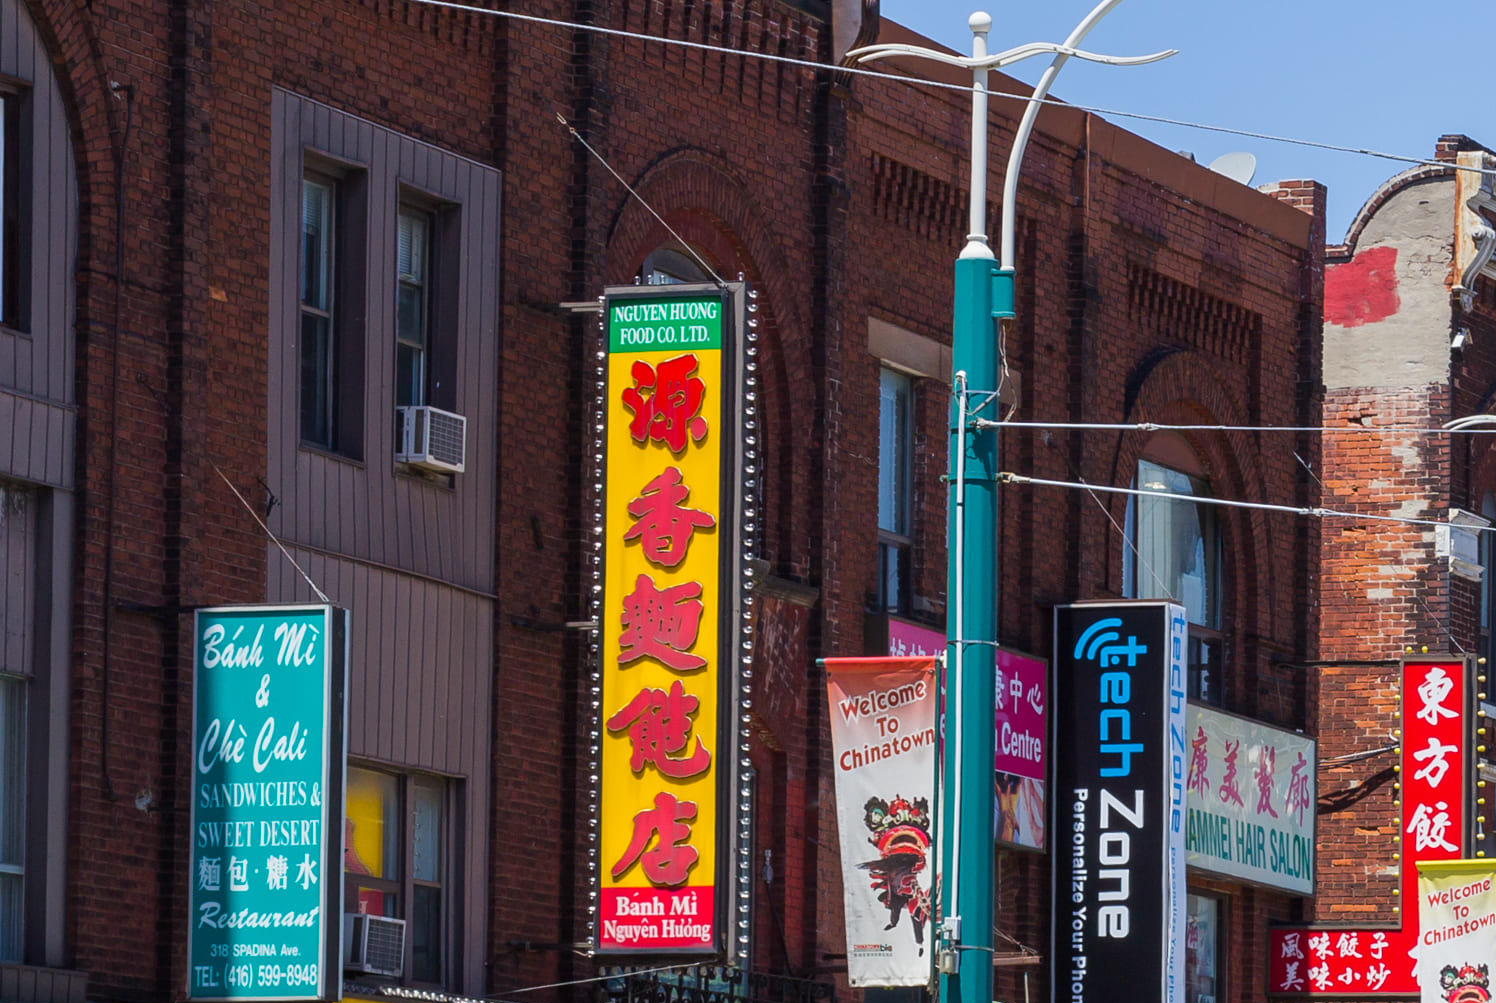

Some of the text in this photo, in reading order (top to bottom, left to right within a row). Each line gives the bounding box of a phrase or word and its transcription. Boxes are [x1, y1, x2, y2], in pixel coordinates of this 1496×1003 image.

[614, 301, 717, 324] NGUYEN HUONG
[620, 325, 711, 345] FOOD CO. LTD.
[203, 623, 264, 669] Bánh
[255, 674, 271, 708] &
[838, 679, 927, 726] Welcome
[876, 715, 900, 741] To
[1170, 612, 1186, 835] tech Zone
[198, 716, 307, 773] Chè Cali
[839, 728, 937, 773] Chinatown
[1001, 722, 1042, 763] Centre
[200, 781, 321, 809] SANDWICHES &
[1098, 635, 1148, 939] tech Zone
[199, 819, 320, 847] SWEET DESERT
[1072, 788, 1089, 903] Personalize
[1235, 820, 1312, 881] HAIR SALON
[615, 890, 698, 917] Bánh Mì
[1427, 877, 1492, 909] Welcome
[198, 901, 320, 929] Restaurant
[1071, 906, 1088, 951] Your
[1453, 904, 1470, 921] To
[603, 917, 659, 943] Nguyên
[1424, 912, 1496, 947] Chinatown
[210, 943, 302, 957] 318 SPADINA Ave.
[194, 962, 318, 989] TEL: (416) 599-8948
[1280, 962, 1391, 991] 美味小炒
